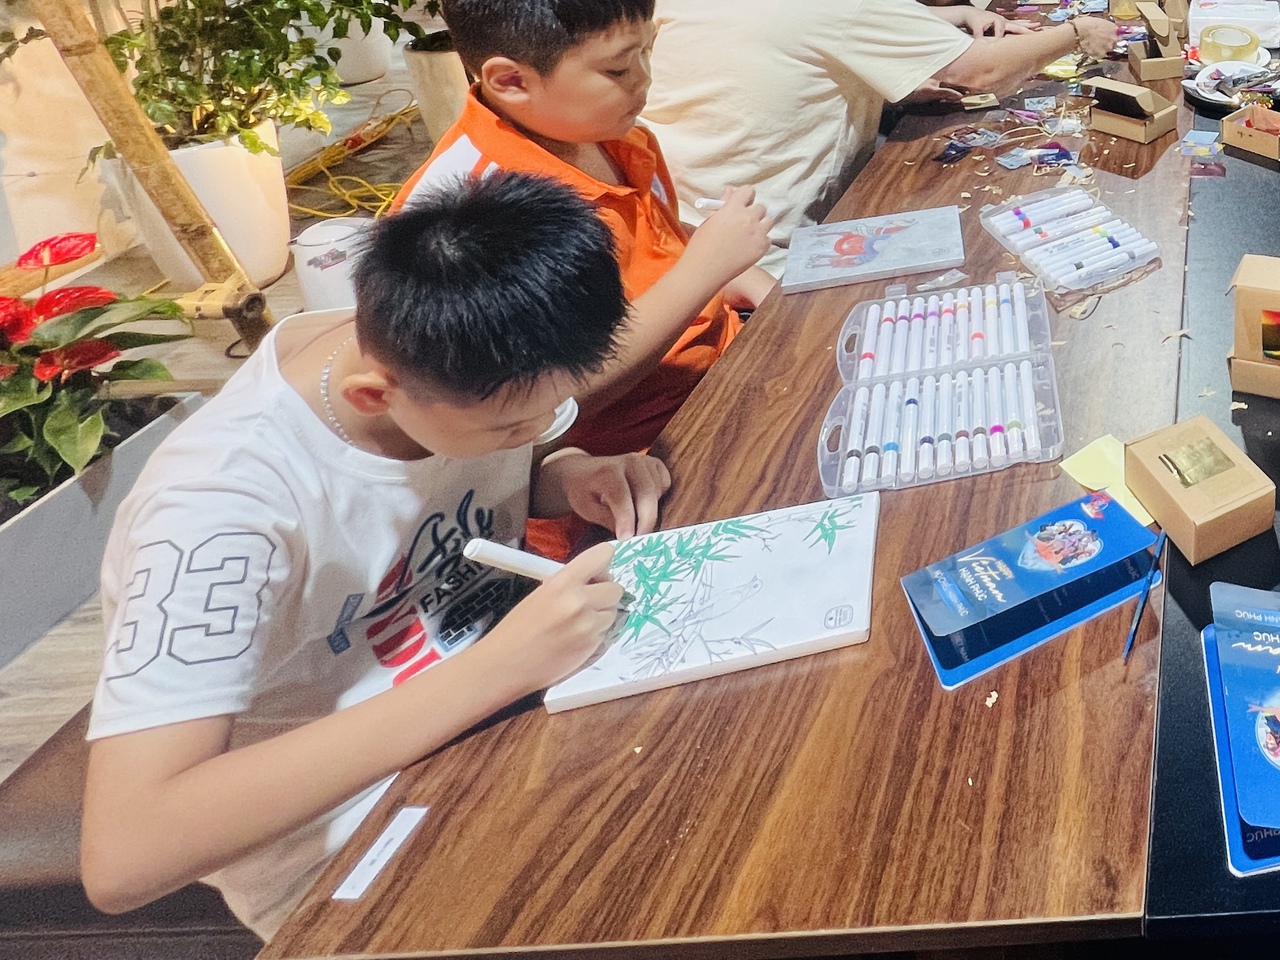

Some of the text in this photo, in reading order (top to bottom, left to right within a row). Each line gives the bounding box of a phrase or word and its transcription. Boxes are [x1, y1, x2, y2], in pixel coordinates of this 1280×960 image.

[995, 559, 1015, 579] HAPPY
[959, 567, 988, 601] HẠNH PHÚC
[105, 531, 276, 682] 33
[1234, 609, 1263, 622] PHÚC
